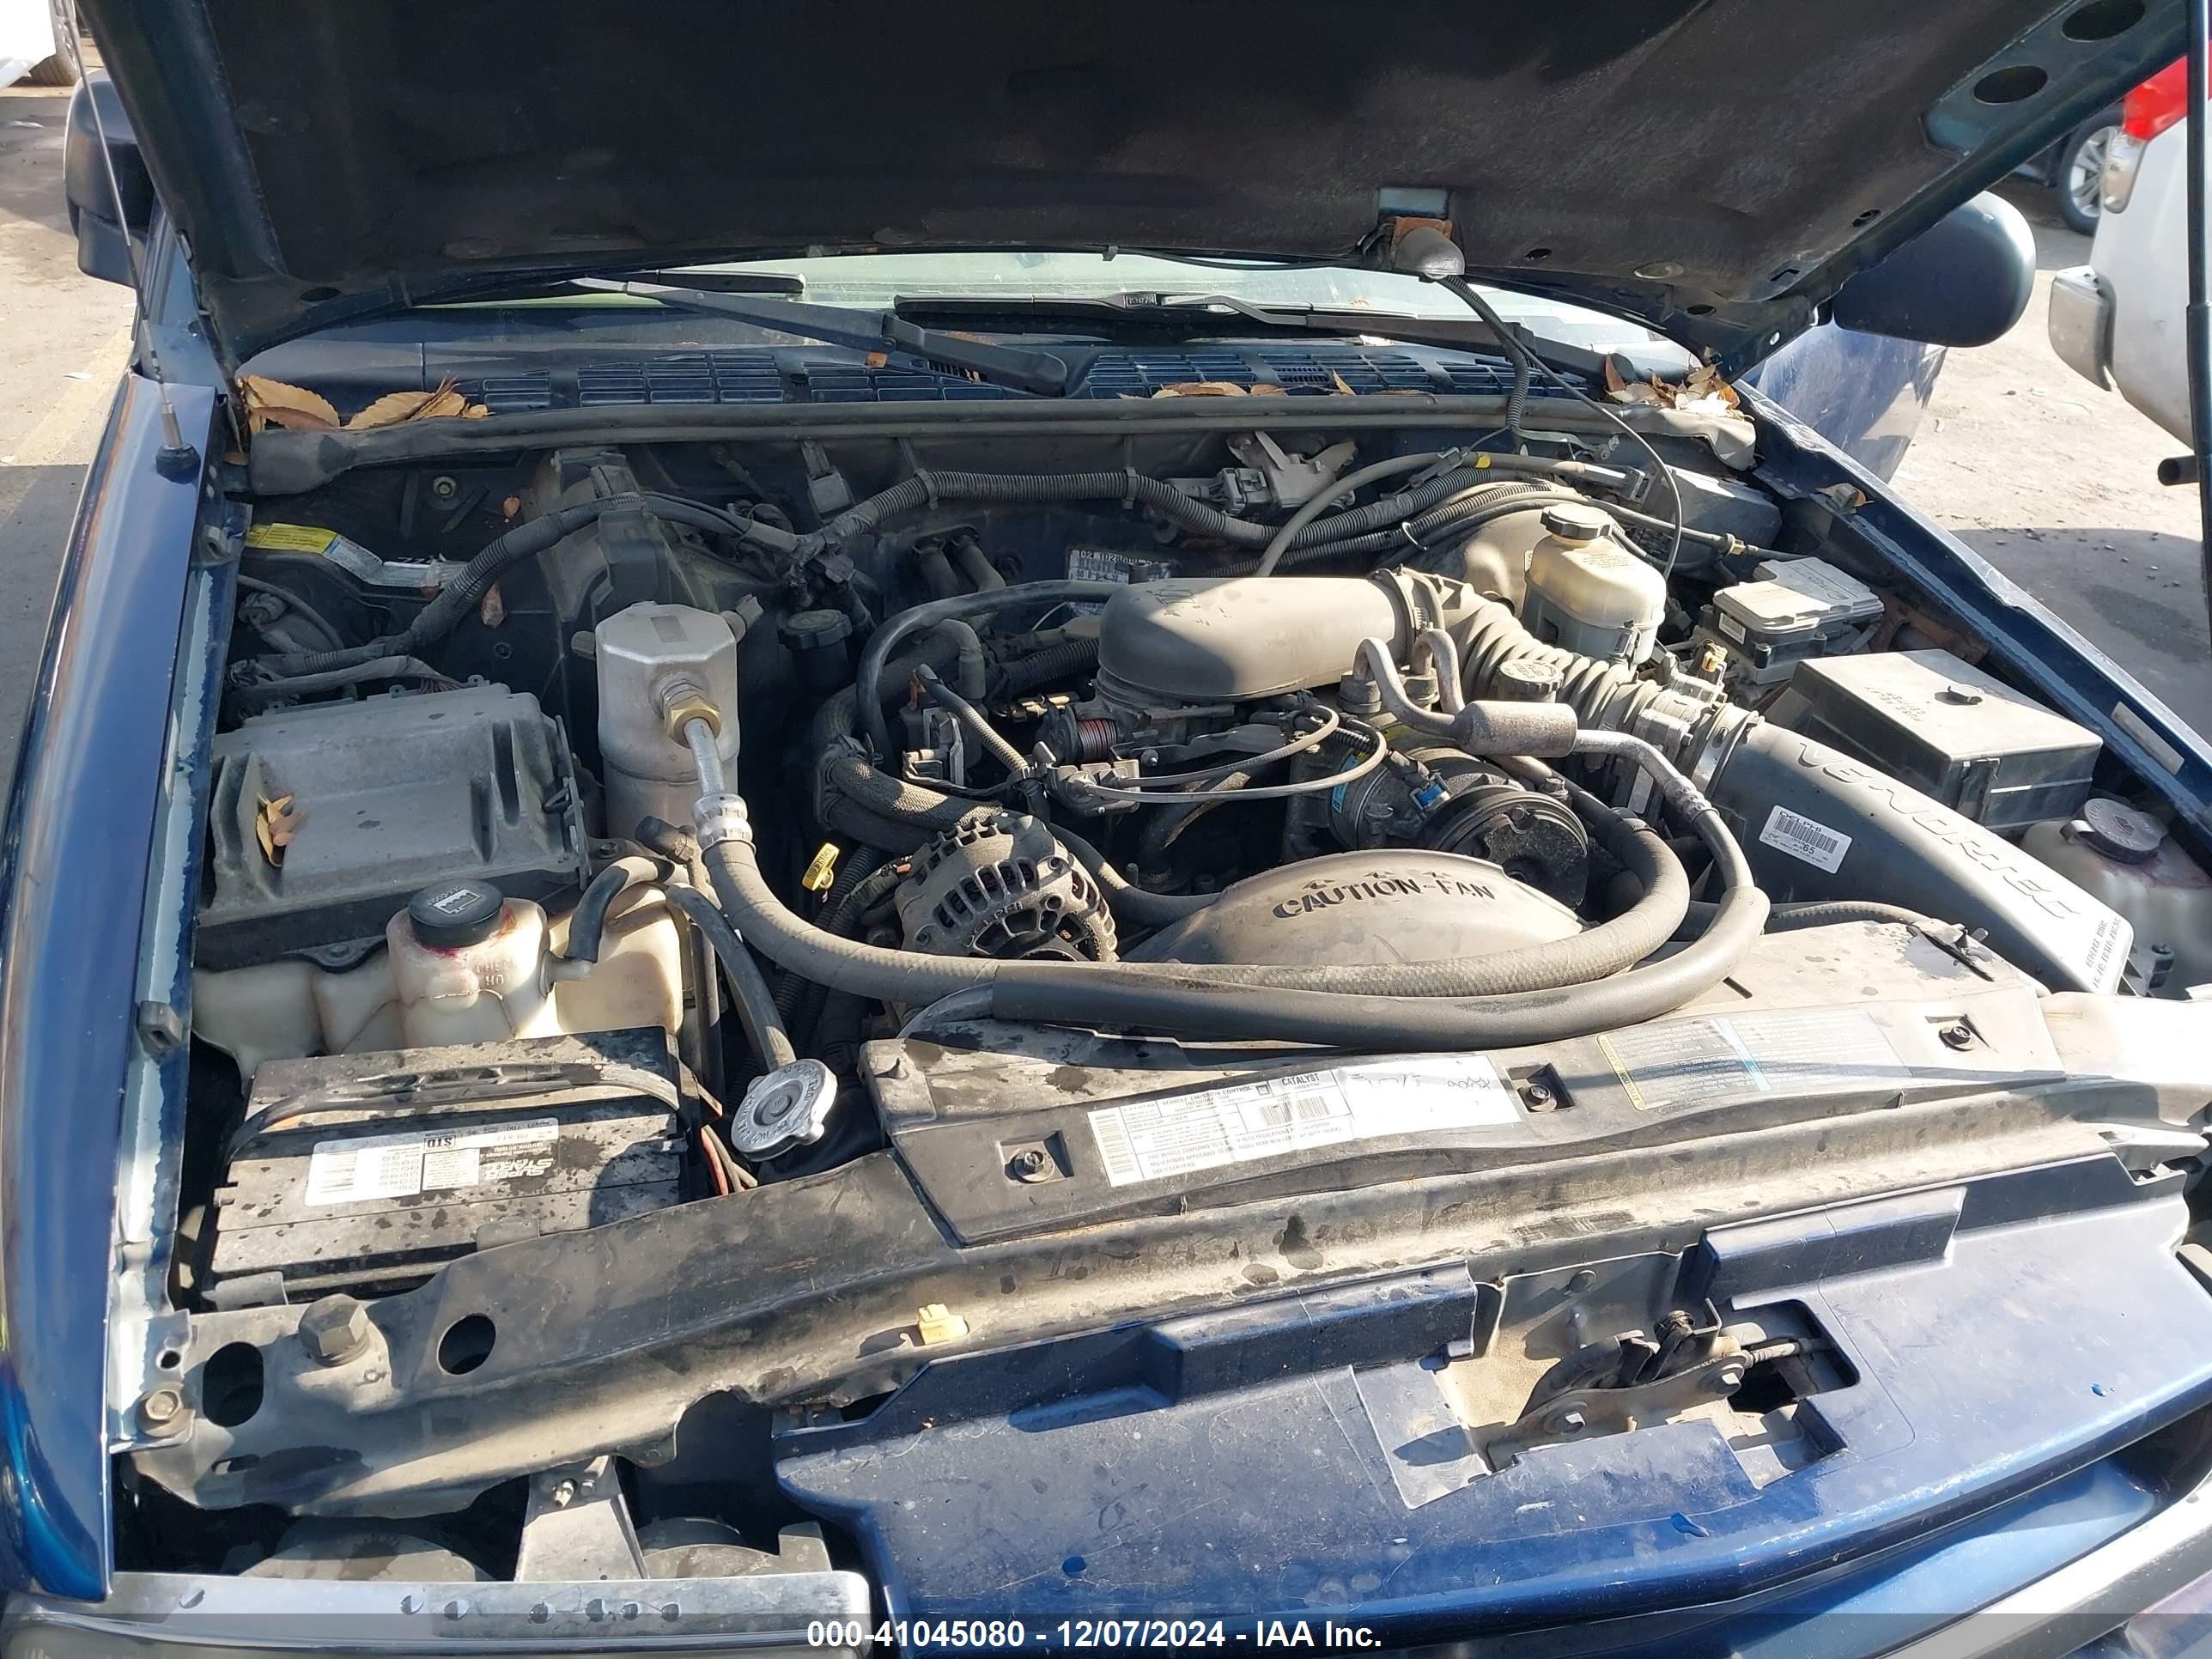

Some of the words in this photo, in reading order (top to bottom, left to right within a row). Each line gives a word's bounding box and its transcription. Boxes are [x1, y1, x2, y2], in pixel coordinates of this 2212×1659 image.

[1779, 811, 1822, 833] DELPHI
[1802, 843, 1816, 855] 65
[1281, 1073, 1320, 1087] CATALYST
[1222, 1085, 1253, 1095] CONTROL
[489, 1157, 554, 1174] START
[484, 1166, 544, 1181] SUPER
